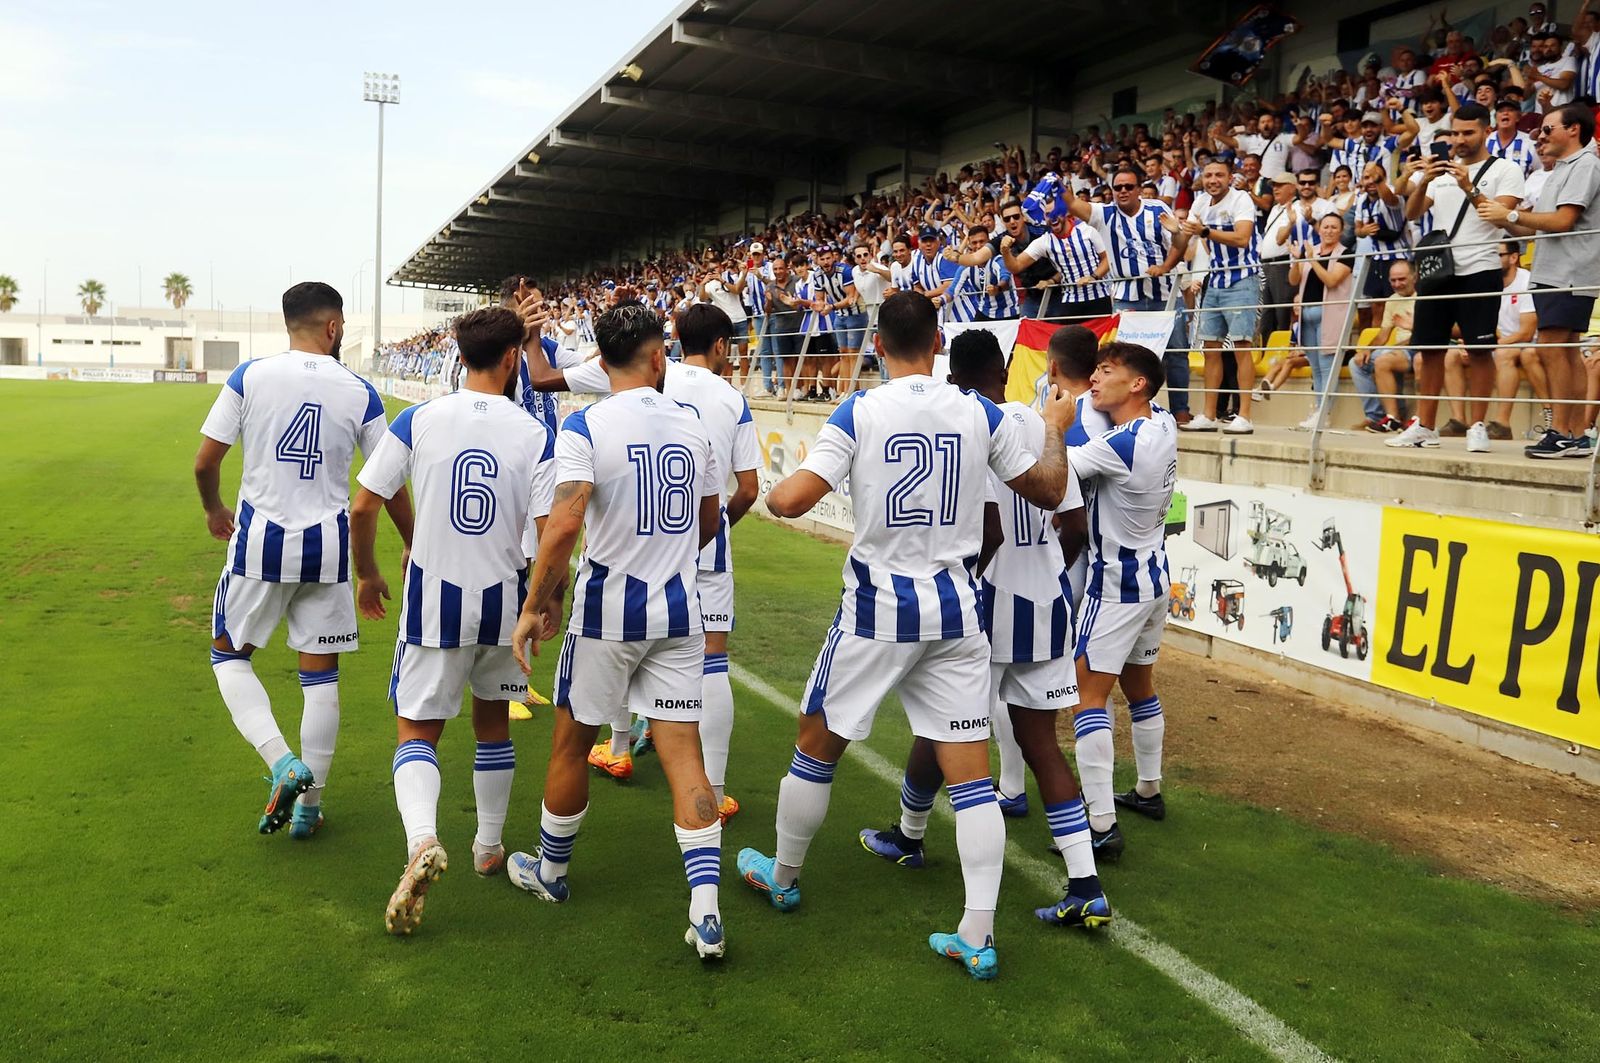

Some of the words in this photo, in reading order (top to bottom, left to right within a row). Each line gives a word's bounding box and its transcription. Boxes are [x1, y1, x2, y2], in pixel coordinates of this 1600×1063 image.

[276, 402, 323, 480] 4
[884, 432, 962, 528] 21
[450, 448, 498, 536] 6
[627, 443, 695, 535] 18
[1145, 647, 1160, 656] RO
[1386, 533, 1475, 685] EL
[1499, 552, 1600, 715] PI
